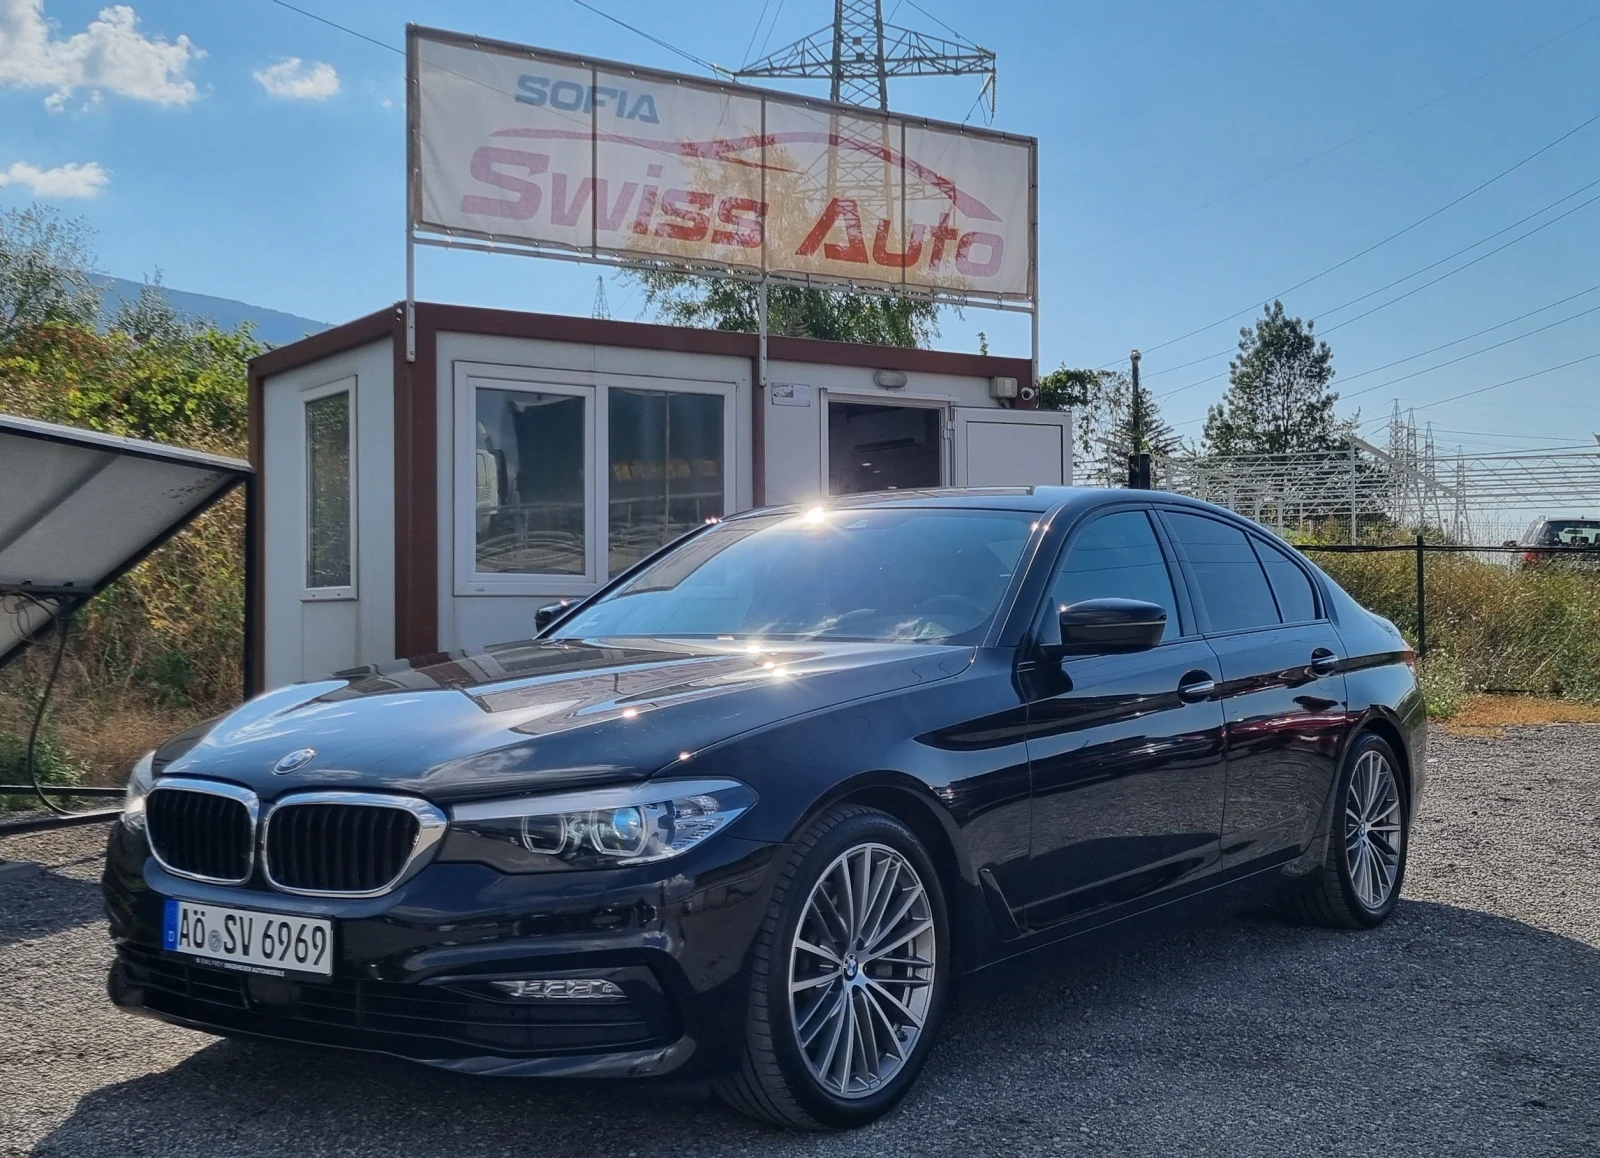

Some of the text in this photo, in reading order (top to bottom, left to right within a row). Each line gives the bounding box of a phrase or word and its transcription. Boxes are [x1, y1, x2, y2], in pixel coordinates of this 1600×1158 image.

[515, 75, 660, 125] SOFIA
[460, 146, 1004, 278] Swiss Auto
[179, 908, 327, 966] AÖ SV 6969
